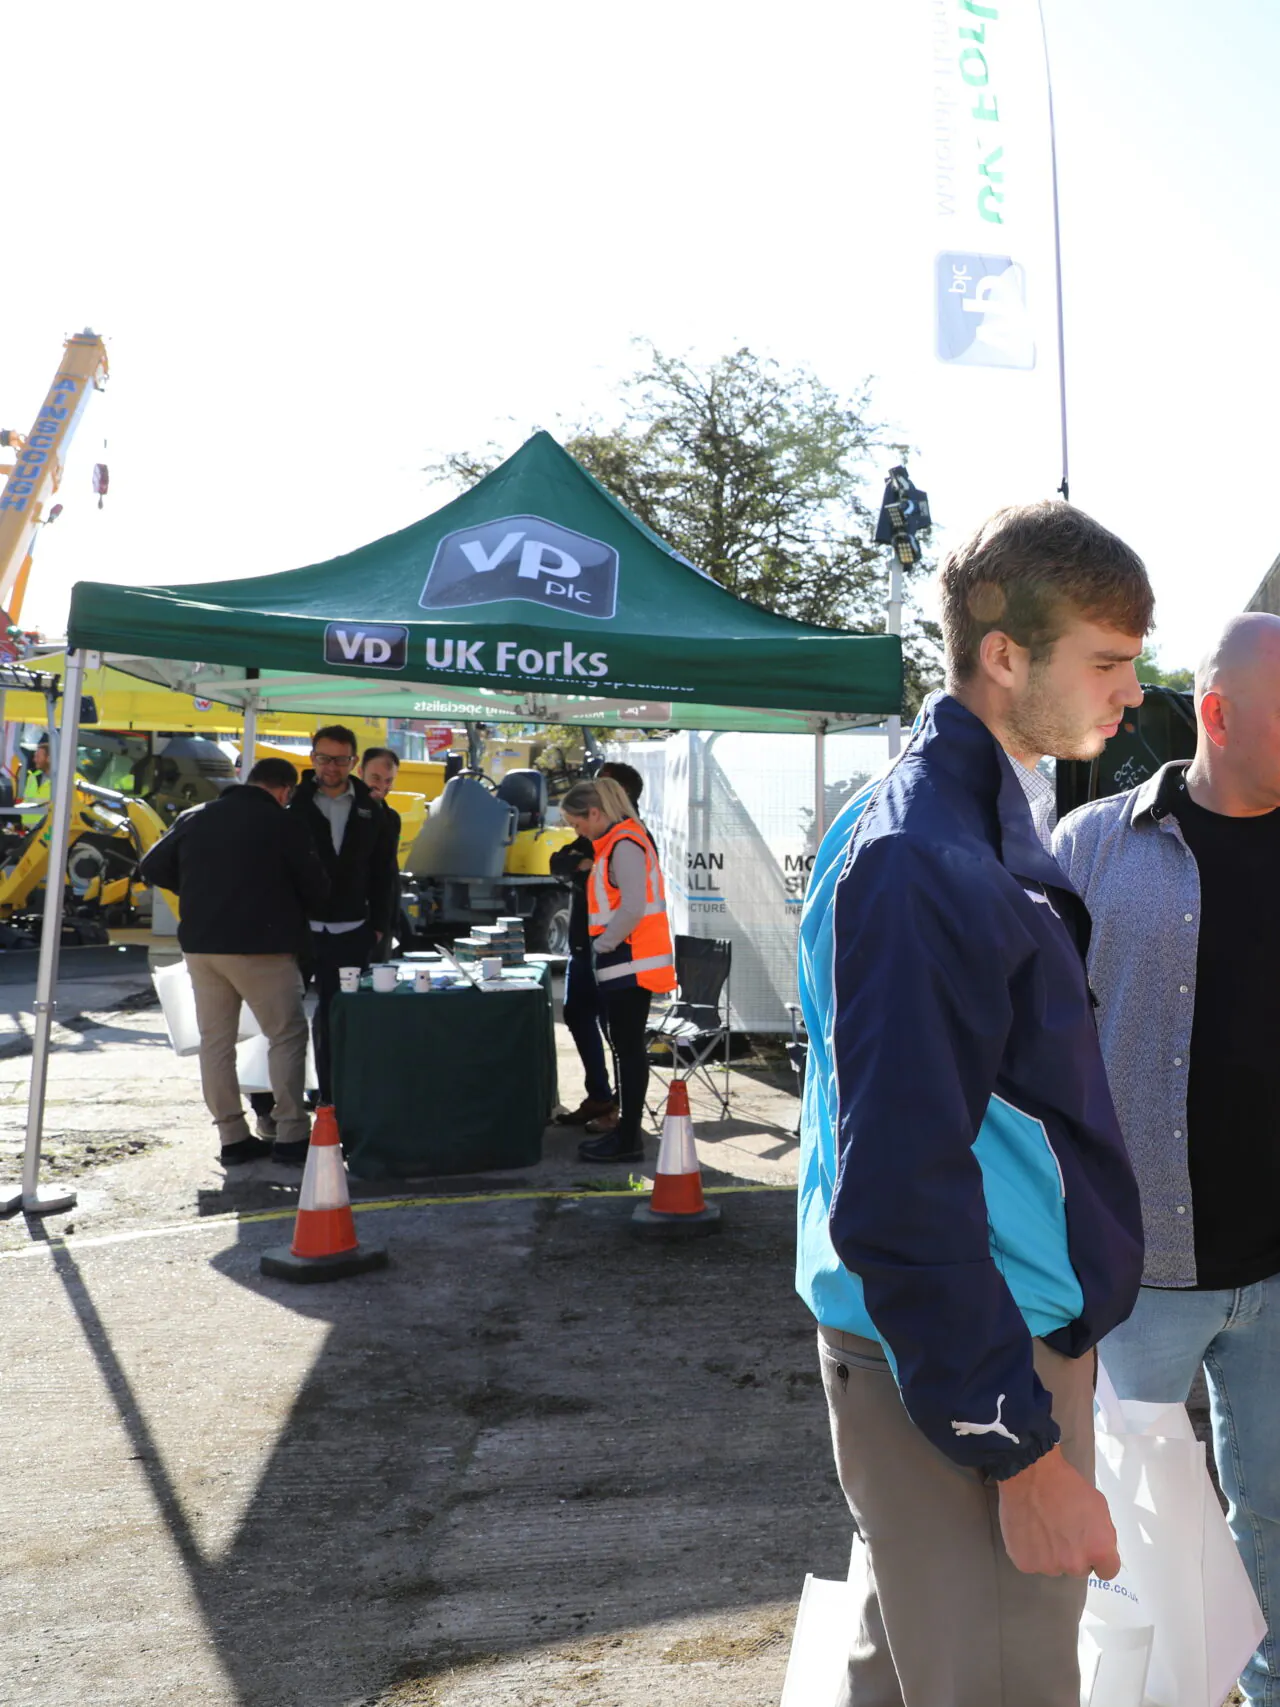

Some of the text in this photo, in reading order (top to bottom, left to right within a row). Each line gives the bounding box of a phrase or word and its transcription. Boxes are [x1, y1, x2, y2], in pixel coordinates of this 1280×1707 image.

[0, 377, 77, 512] AINSCOUGH
[545, 580, 592, 604] plc
[425, 637, 608, 677] UK Forks
